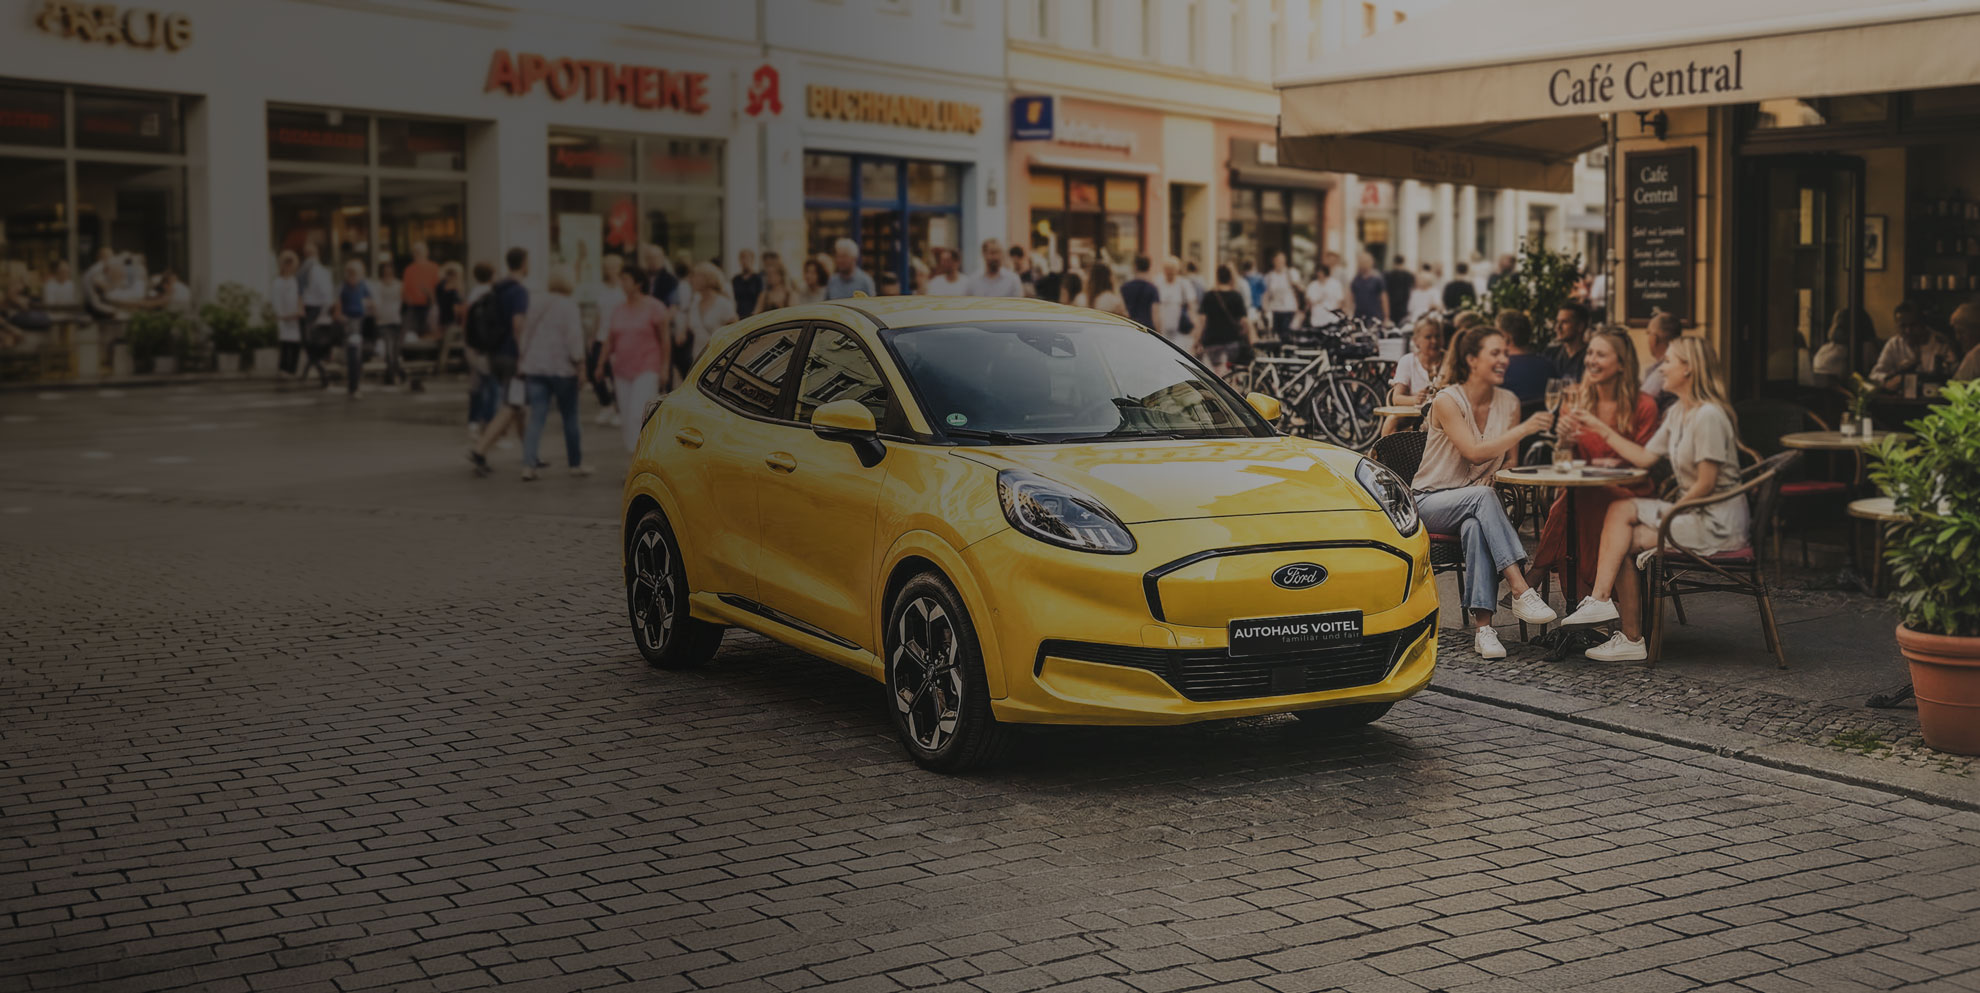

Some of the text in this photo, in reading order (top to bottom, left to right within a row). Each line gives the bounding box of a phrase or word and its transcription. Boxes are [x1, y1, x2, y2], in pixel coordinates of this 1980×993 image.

[484, 49, 710, 117] APOTHEKE
[1549, 49, 1744, 107] Café Central
[807, 85, 983, 135] BUCHHANDLUNG
[1640, 164, 1669, 184] Café
[1633, 186, 1679, 204] Central
[1283, 566, 1318, 585] Ford
[1234, 620, 1359, 639] AUTOHAUS VOITEL
[1322, 632, 1340, 640] und
